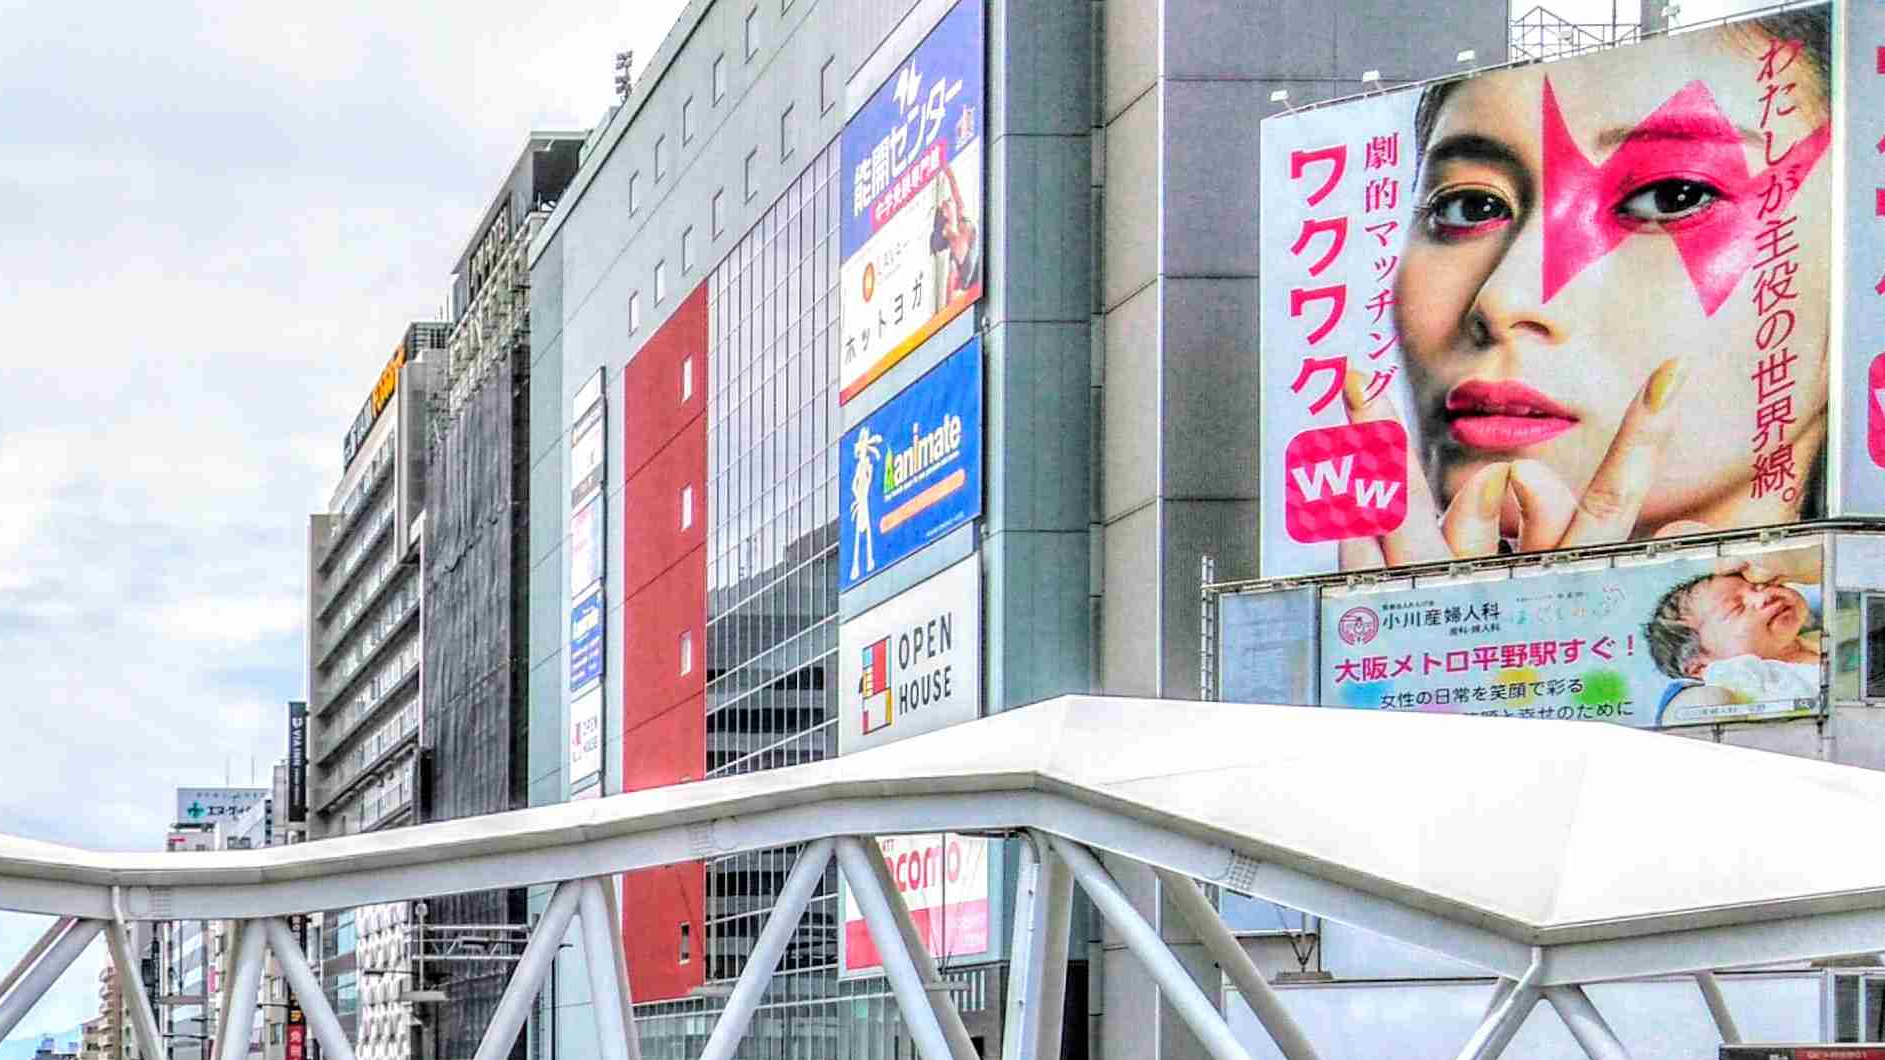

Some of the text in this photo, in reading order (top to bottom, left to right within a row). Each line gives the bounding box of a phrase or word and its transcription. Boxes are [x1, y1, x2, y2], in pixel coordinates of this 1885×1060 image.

[1289, 143, 1348, 418] ワクワク
[1363, 131, 1399, 401] 劇的マッチング
[1751, 36, 1805, 503] わたしが主役の世界線。
[845, 270, 923, 365] ホットヨガ
[894, 413, 963, 488] animate
[898, 611, 953, 670] OPEN
[1382, 602, 1500, 630] 小川産婦人科
[1334, 634, 1635, 684] 大阪メトロ平野駅すぐ！
[898, 664, 953, 716] HOUSE
[1380, 678, 1584, 710] 女性の日常を笑顔で彩る
[292, 728, 303, 749] VIA
[883, 840, 960, 892] como
